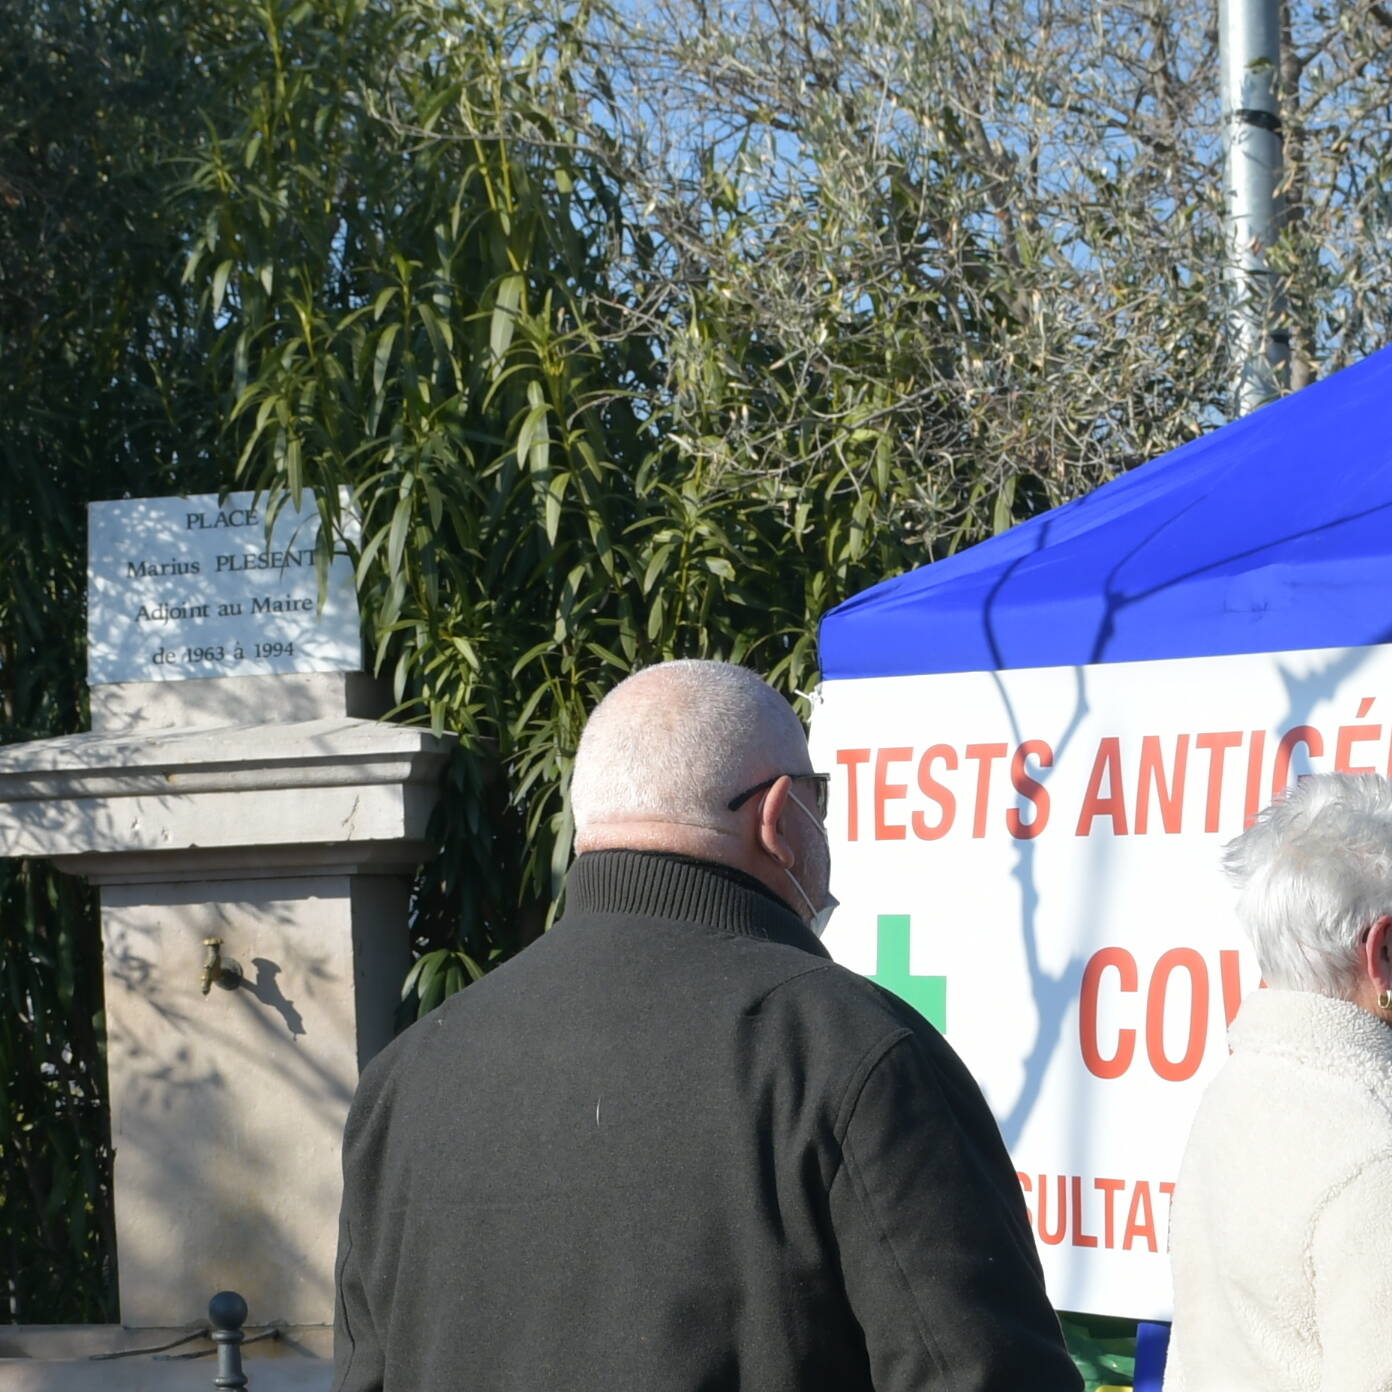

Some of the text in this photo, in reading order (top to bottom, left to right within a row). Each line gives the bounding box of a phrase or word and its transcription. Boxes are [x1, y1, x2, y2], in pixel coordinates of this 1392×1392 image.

[186, 510, 259, 530] PLACE
[126, 558, 200, 578] Marius
[135, 595, 313, 626] Adjoint au Maire
[152, 641, 295, 665] de 1963 à 1994
[836, 739, 1054, 842] TESTS
